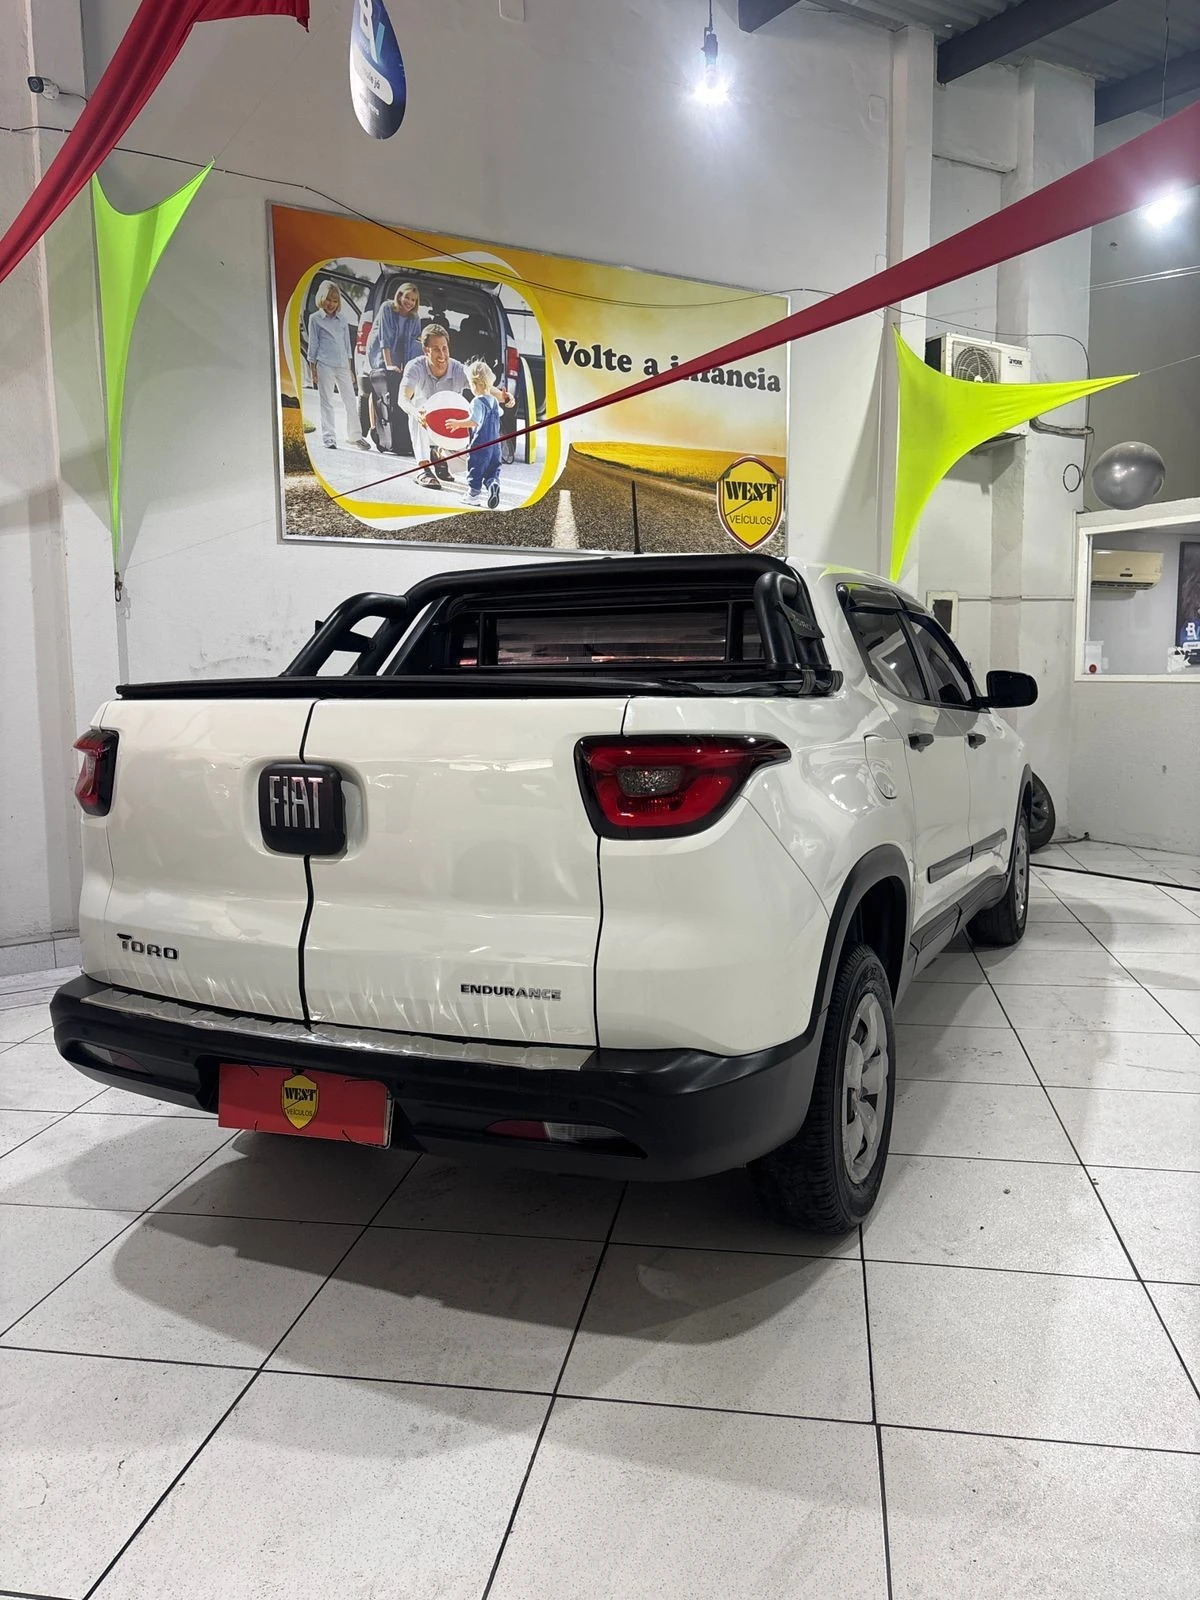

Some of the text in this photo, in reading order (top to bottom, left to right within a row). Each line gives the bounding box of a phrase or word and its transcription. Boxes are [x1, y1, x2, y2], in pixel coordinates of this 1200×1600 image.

[554, 338, 632, 373] Volte
[643, 357, 659, 376] a
[725, 480, 778, 502] WEST
[729, 513, 773, 526] VEÍCULOS
[269, 775, 324, 829] FIAT
[116, 933, 179, 960] TORO
[460, 983, 562, 1001] ENDURANCE
[284, 1087, 317, 1102] WEST
